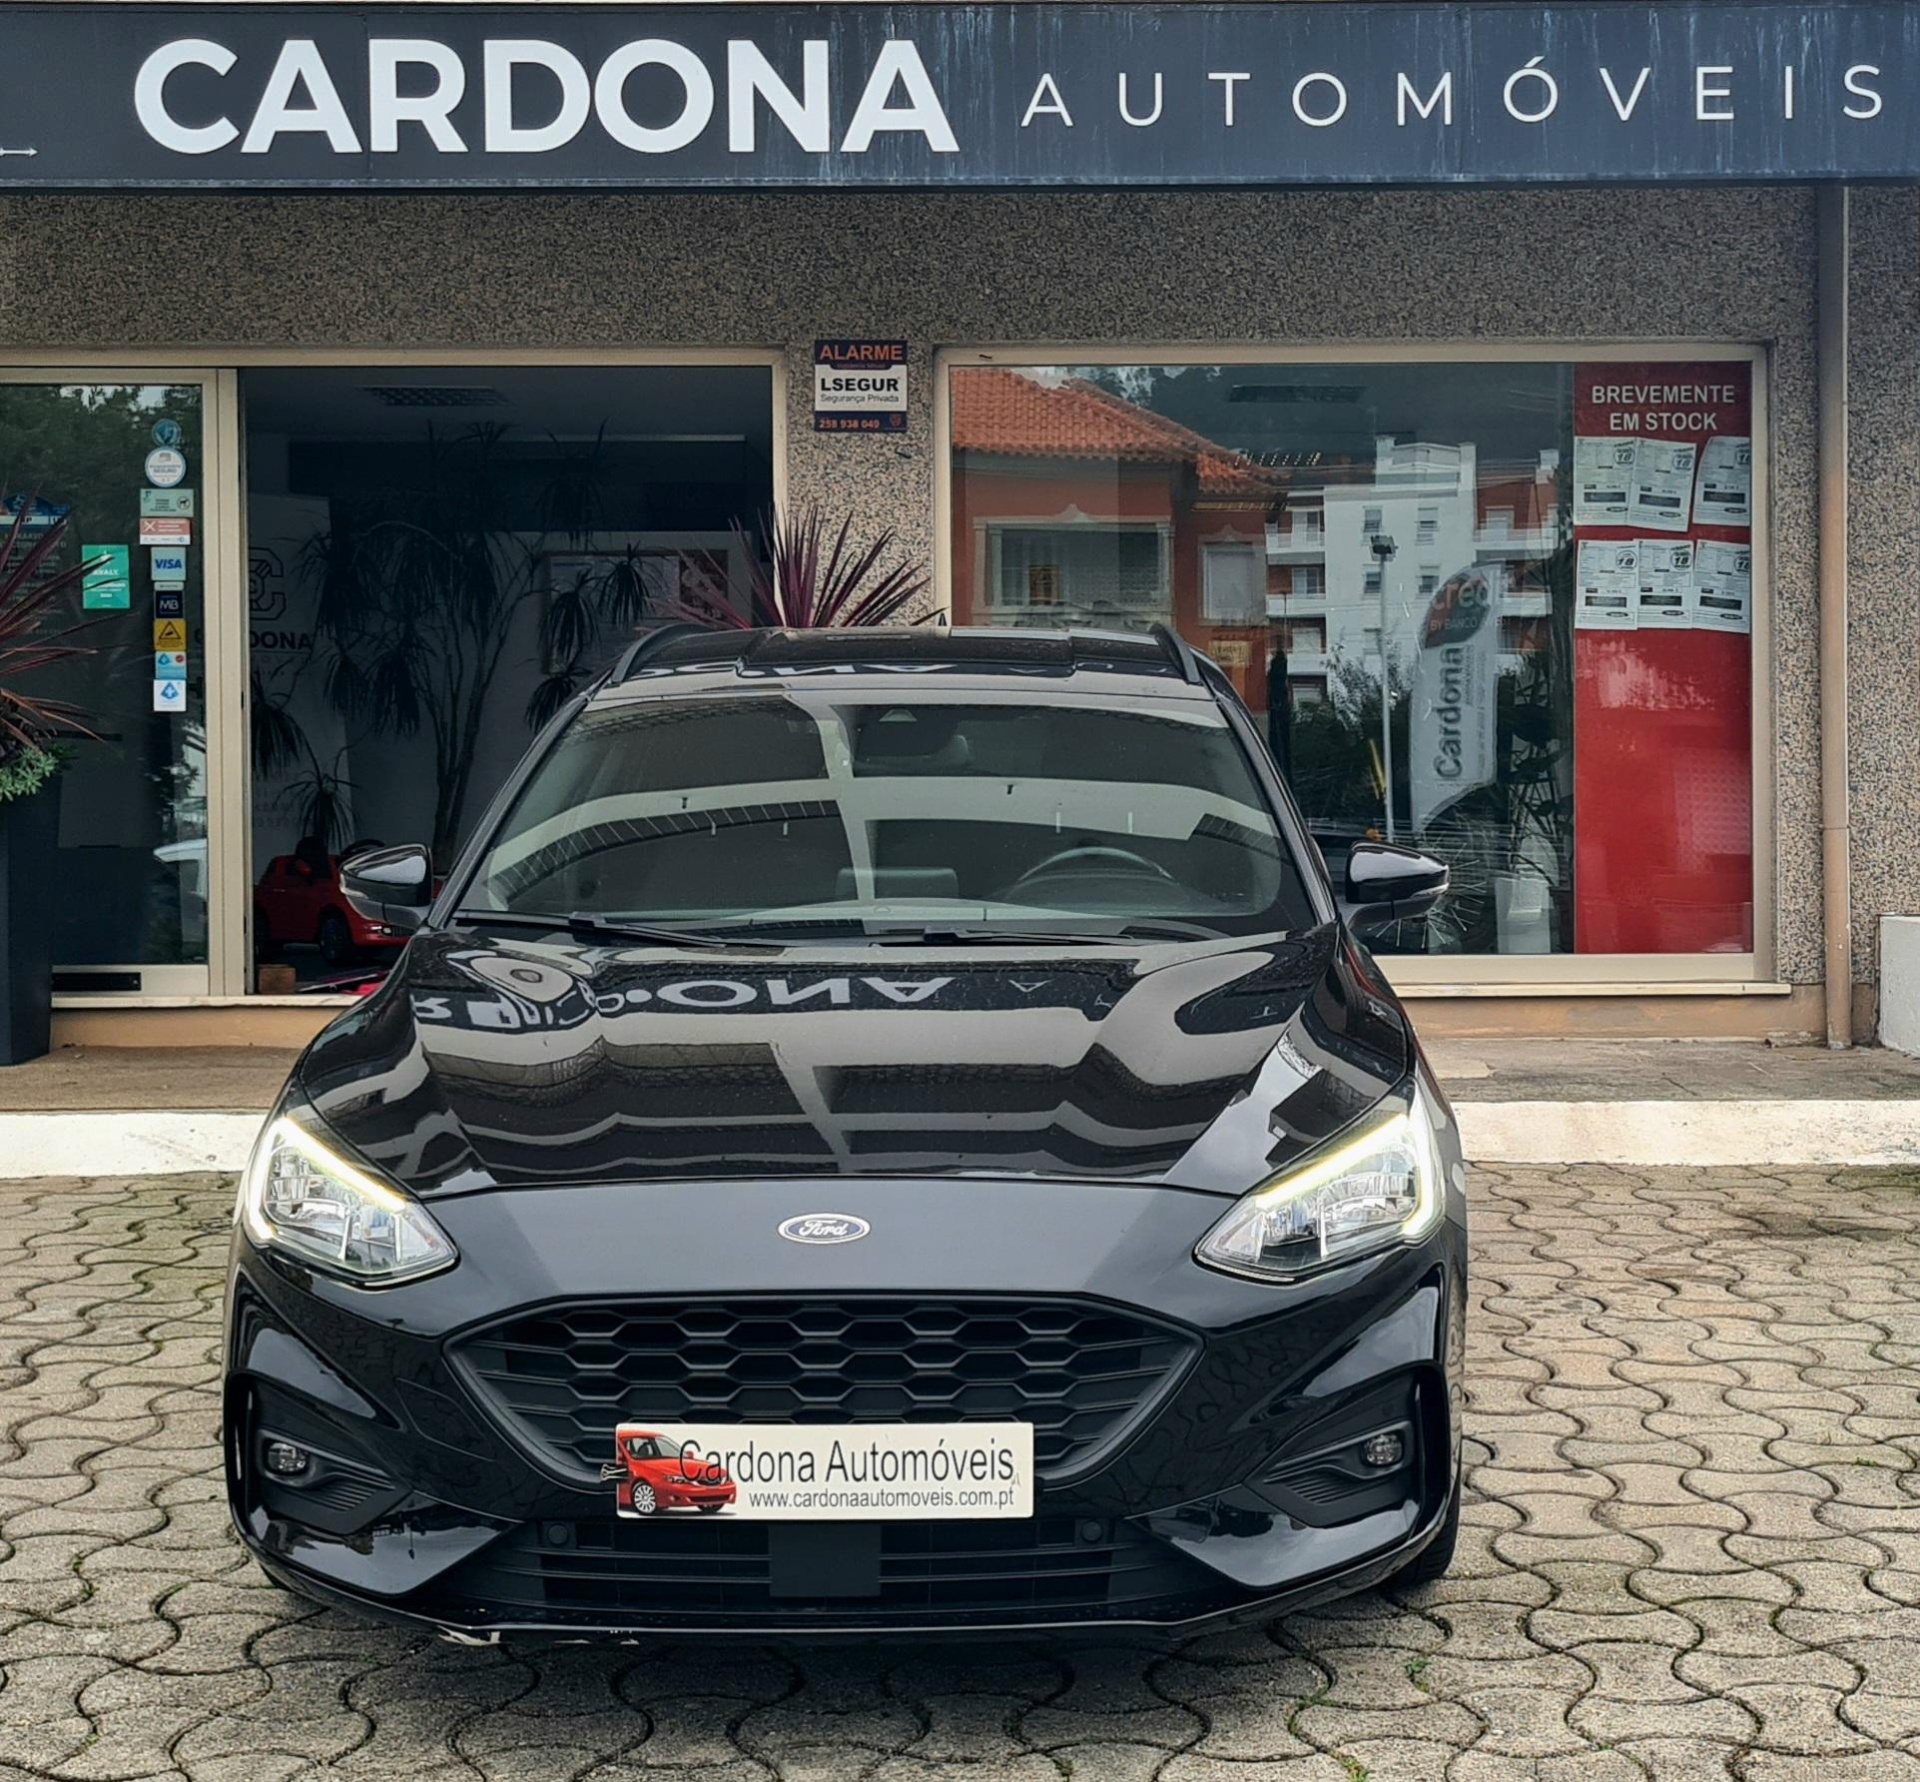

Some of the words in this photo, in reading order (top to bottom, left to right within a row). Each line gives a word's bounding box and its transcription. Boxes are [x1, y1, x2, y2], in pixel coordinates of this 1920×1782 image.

[134, 38, 959, 155] CARDONA
[1020, 55, 1884, 128] AUTOMÓVEIS
[819, 344, 903, 361] ALARME
[820, 377, 900, 392] LSEGUR
[820, 393, 866, 405] Segurança
[867, 393, 900, 403] Privada
[1591, 384, 1736, 404] BREVEMENTE
[1609, 412, 1640, 431] EM
[1644, 411, 1718, 431] STOCK
[154, 558, 182, 570] VISA
[159, 599, 179, 610] MB
[1432, 647, 1463, 778] Cardona
[798, 1219, 850, 1236] Ford
[678, 1438, 815, 1484] Cardona
[824, 1437, 1015, 1484] Automóveis
[748, 1487, 1015, 1509] www.cardonaautomoveis.com.pt
